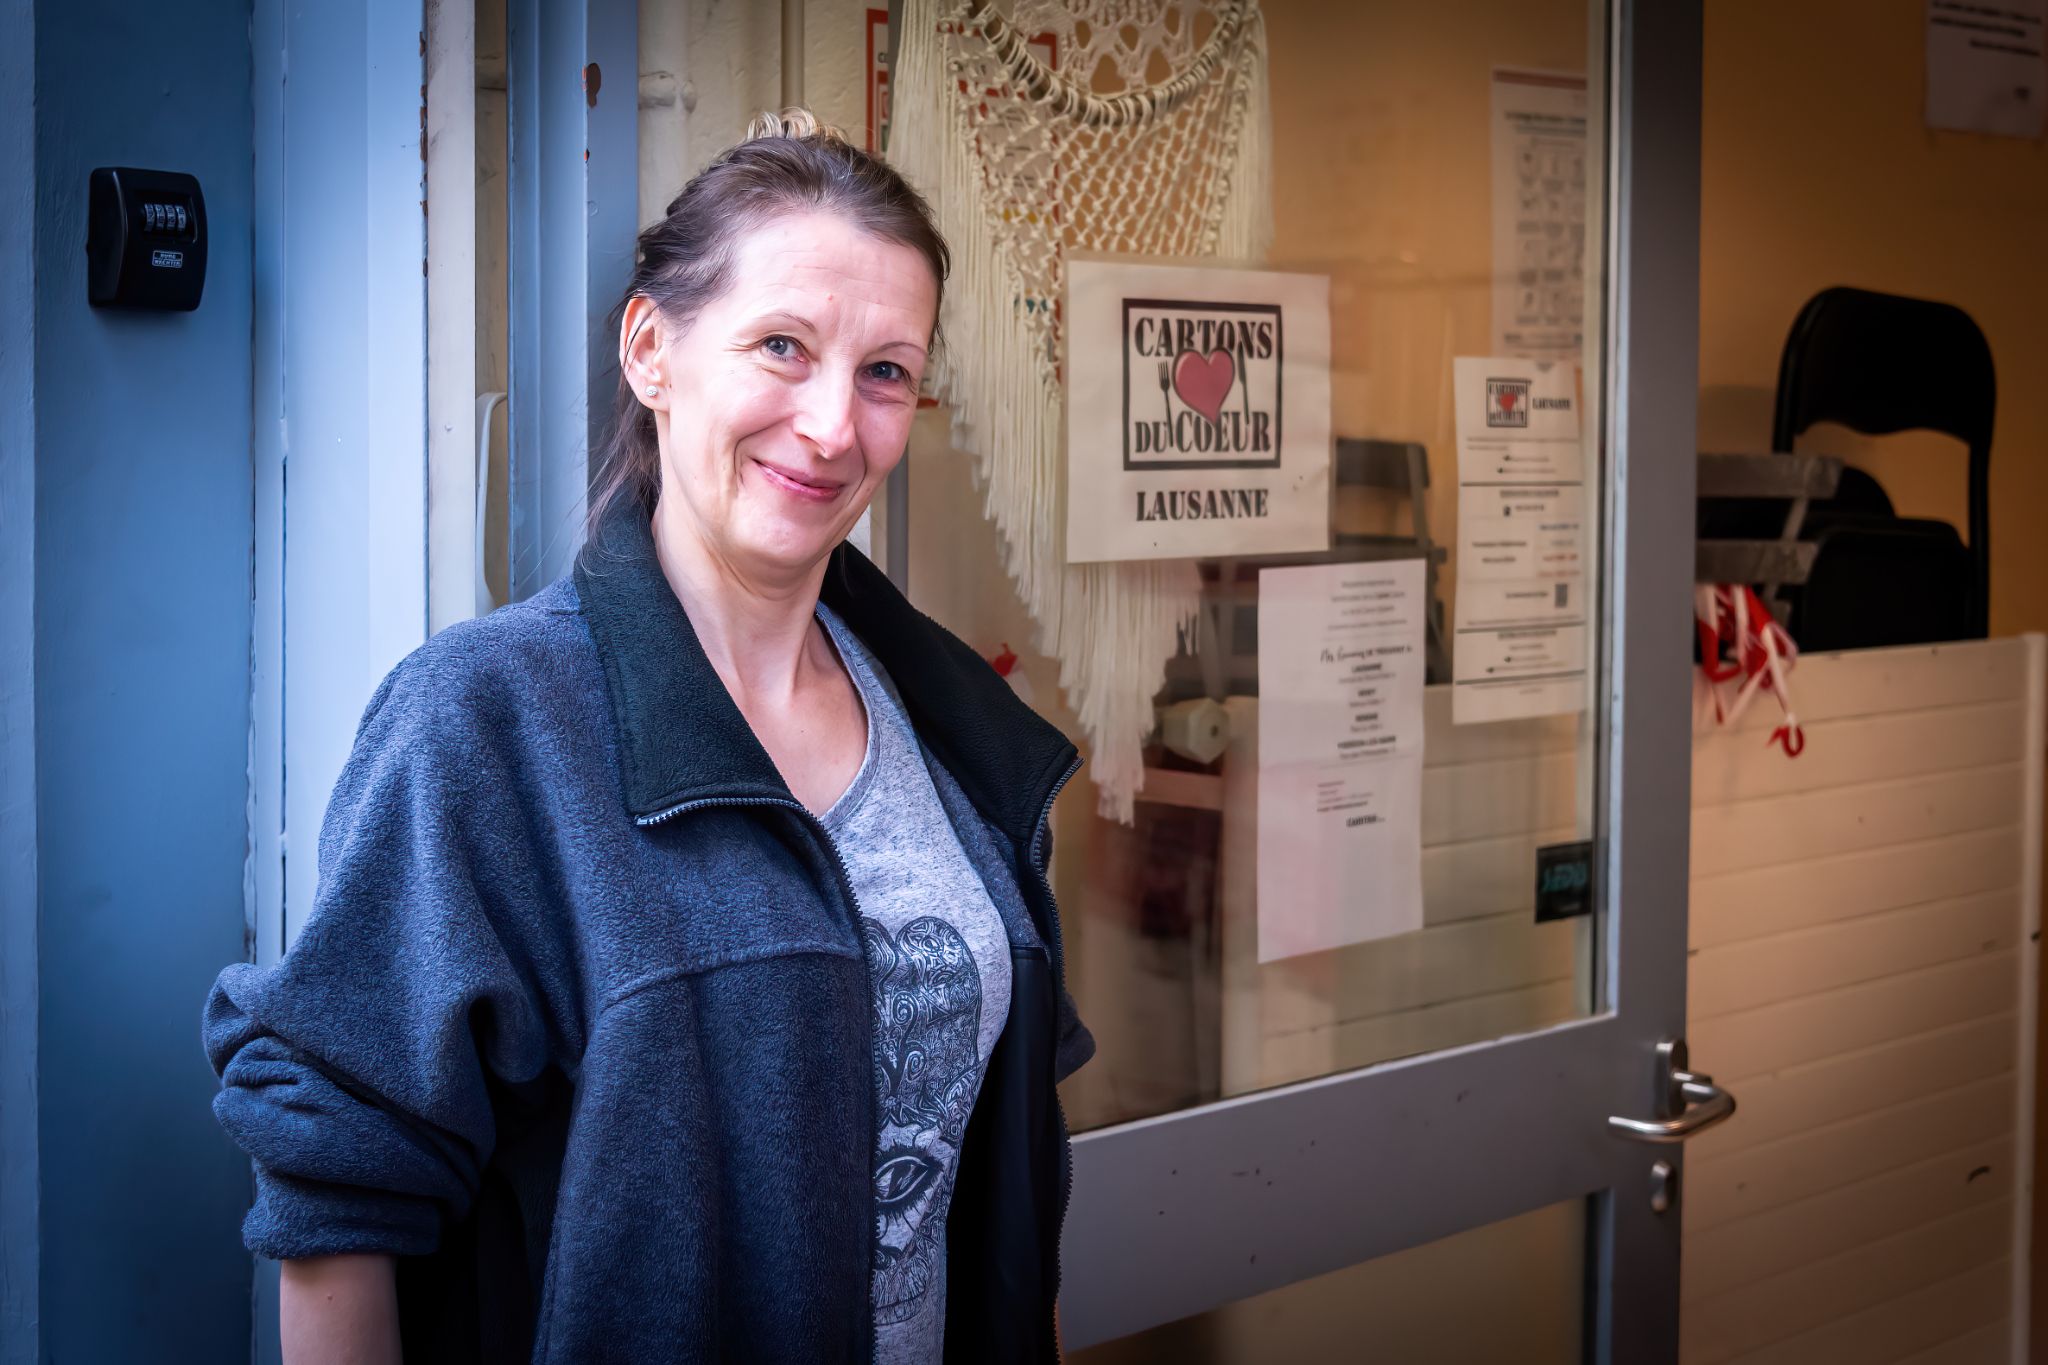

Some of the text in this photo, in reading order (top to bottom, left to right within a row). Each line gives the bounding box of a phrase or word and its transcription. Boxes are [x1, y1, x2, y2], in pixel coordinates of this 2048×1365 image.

[1134, 317, 1273, 359] CARTONS
[1134, 411, 1272, 453] DU COEUR
[1135, 489, 1269, 522] LAUSANNE
